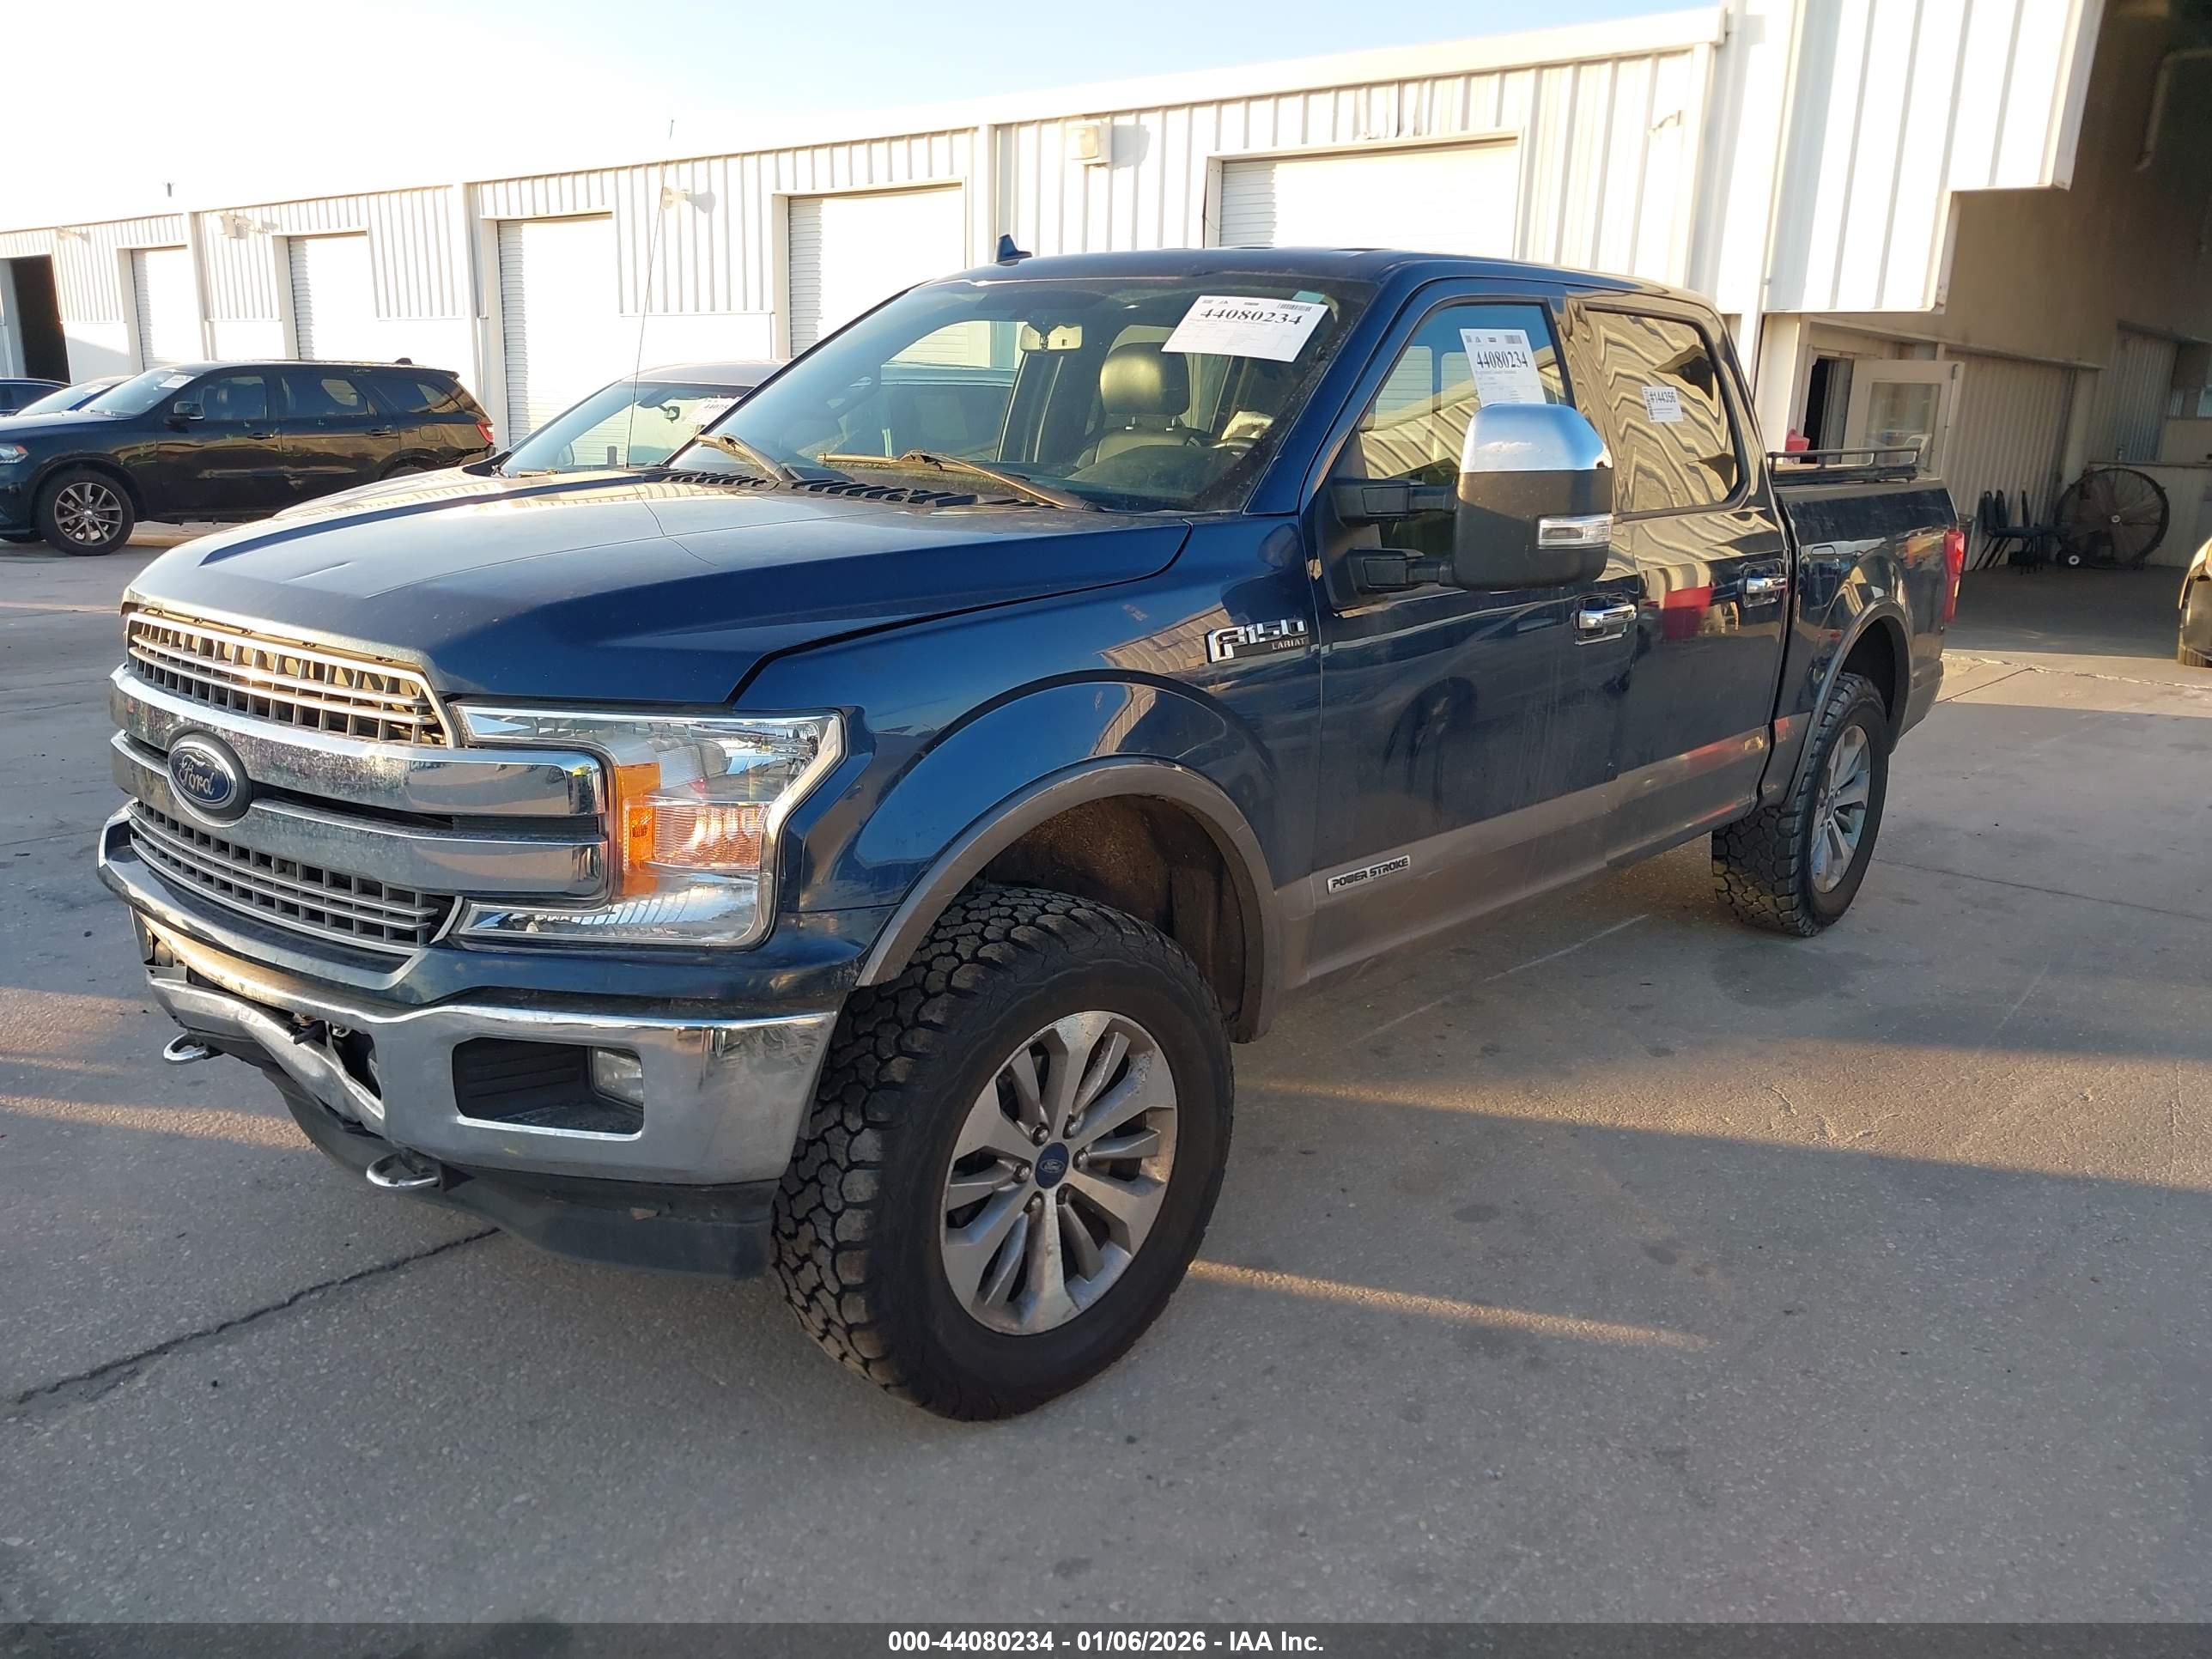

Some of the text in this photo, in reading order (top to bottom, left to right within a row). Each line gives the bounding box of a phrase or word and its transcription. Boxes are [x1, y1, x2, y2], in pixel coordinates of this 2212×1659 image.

[1200, 308, 1304, 325] 44080234
[1477, 350, 1528, 368] 44080234
[1272, 637, 1306, 651] LARIAT
[178, 754, 216, 796] Ford
[1332, 857, 1409, 889] POWER STROKE
